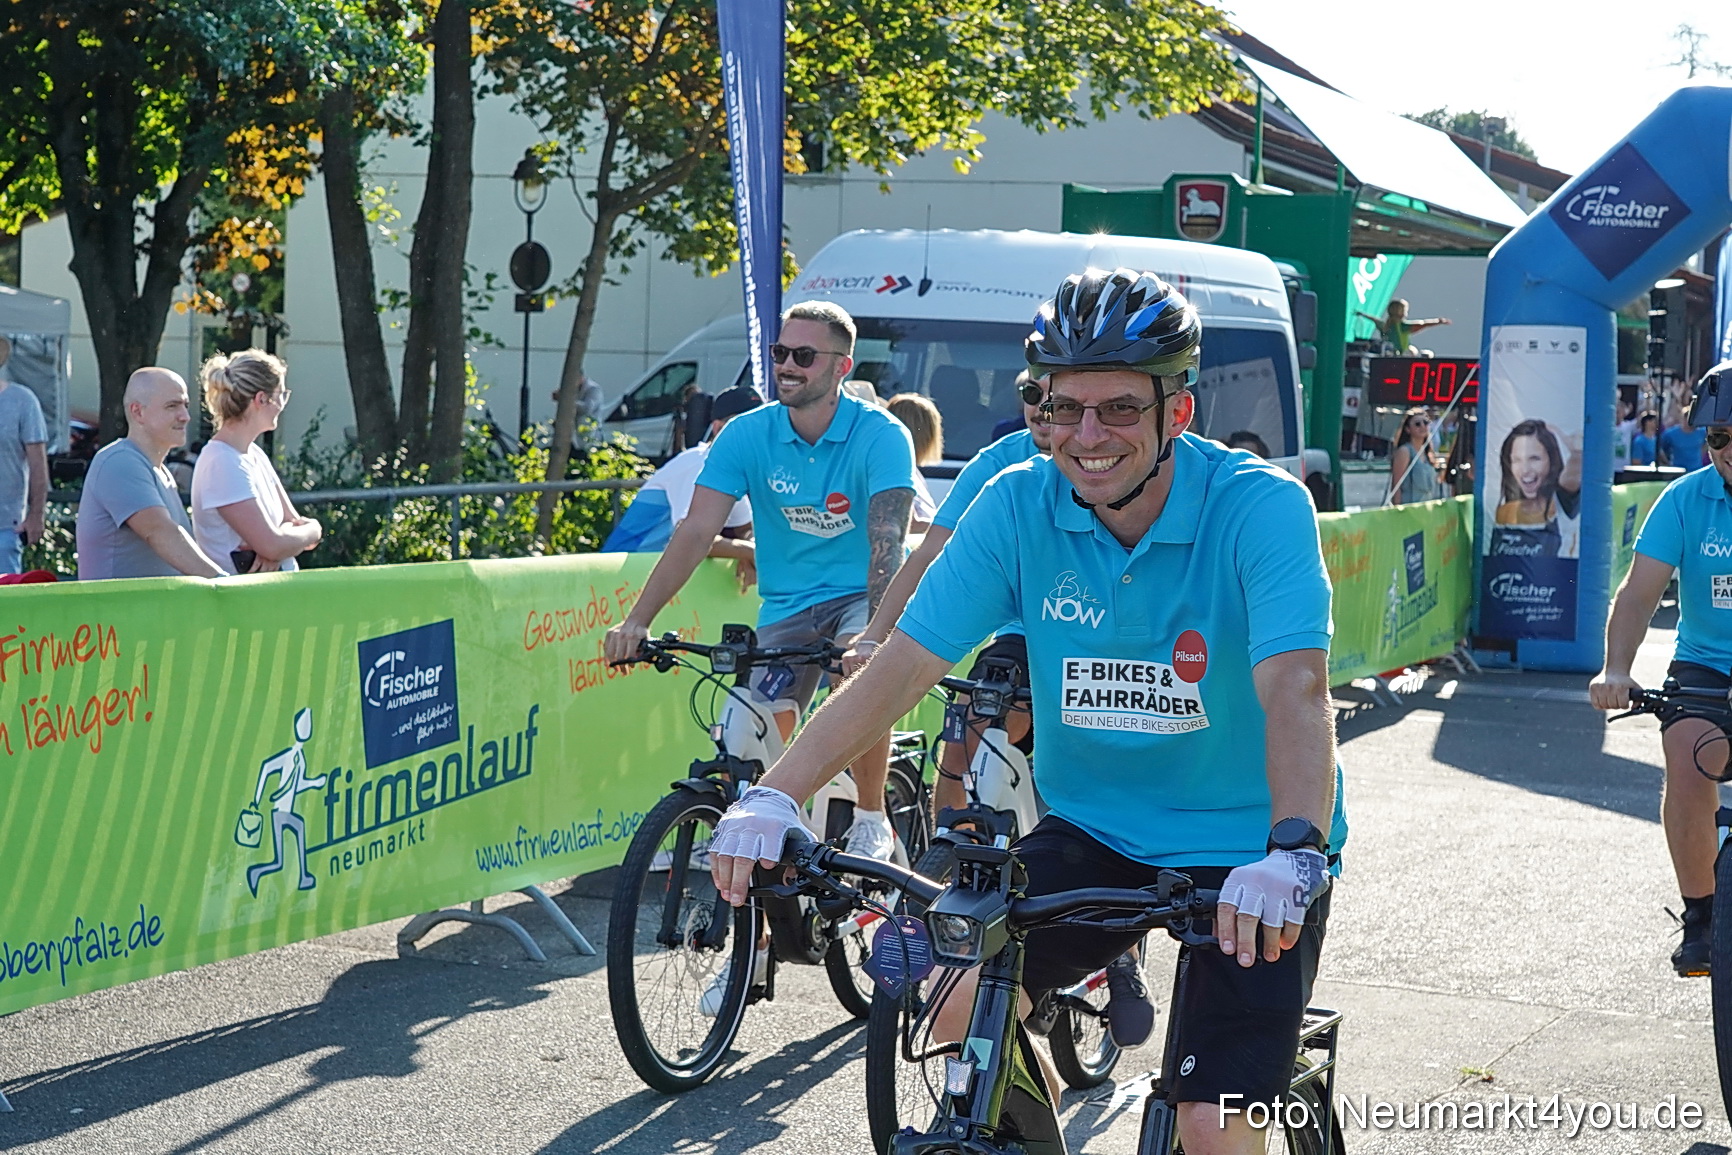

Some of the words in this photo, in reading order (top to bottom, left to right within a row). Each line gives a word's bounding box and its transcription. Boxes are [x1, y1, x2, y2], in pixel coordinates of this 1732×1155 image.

[1582, 200, 1669, 219] Fischer
[1588, 217, 1660, 228] AUTOMOBILE
[767, 478, 800, 495] NOW
[1049, 570, 1101, 605] Bike
[1499, 583, 1556, 597] Fischer
[524, 585, 613, 651] Gesunde
[1042, 597, 1105, 629] NOW
[0, 623, 120, 683] Firmen
[1175, 650, 1205, 662] Pilsach
[379, 664, 443, 699] Fischer
[1066, 661, 1156, 684] E-BIKES
[1160, 668, 1173, 688] &
[21, 664, 153, 754] länger!
[386, 685, 439, 710] AUTOMOBILE
[1065, 687, 1202, 715] FAHRRÄDER
[1065, 713, 1093, 726] DEIN
[1097, 716, 1138, 729] NEUER
[1141, 717, 1207, 733] BIKE-STORE
[324, 704, 539, 844] firmenlauf
[329, 818, 425, 876] neumarkt
